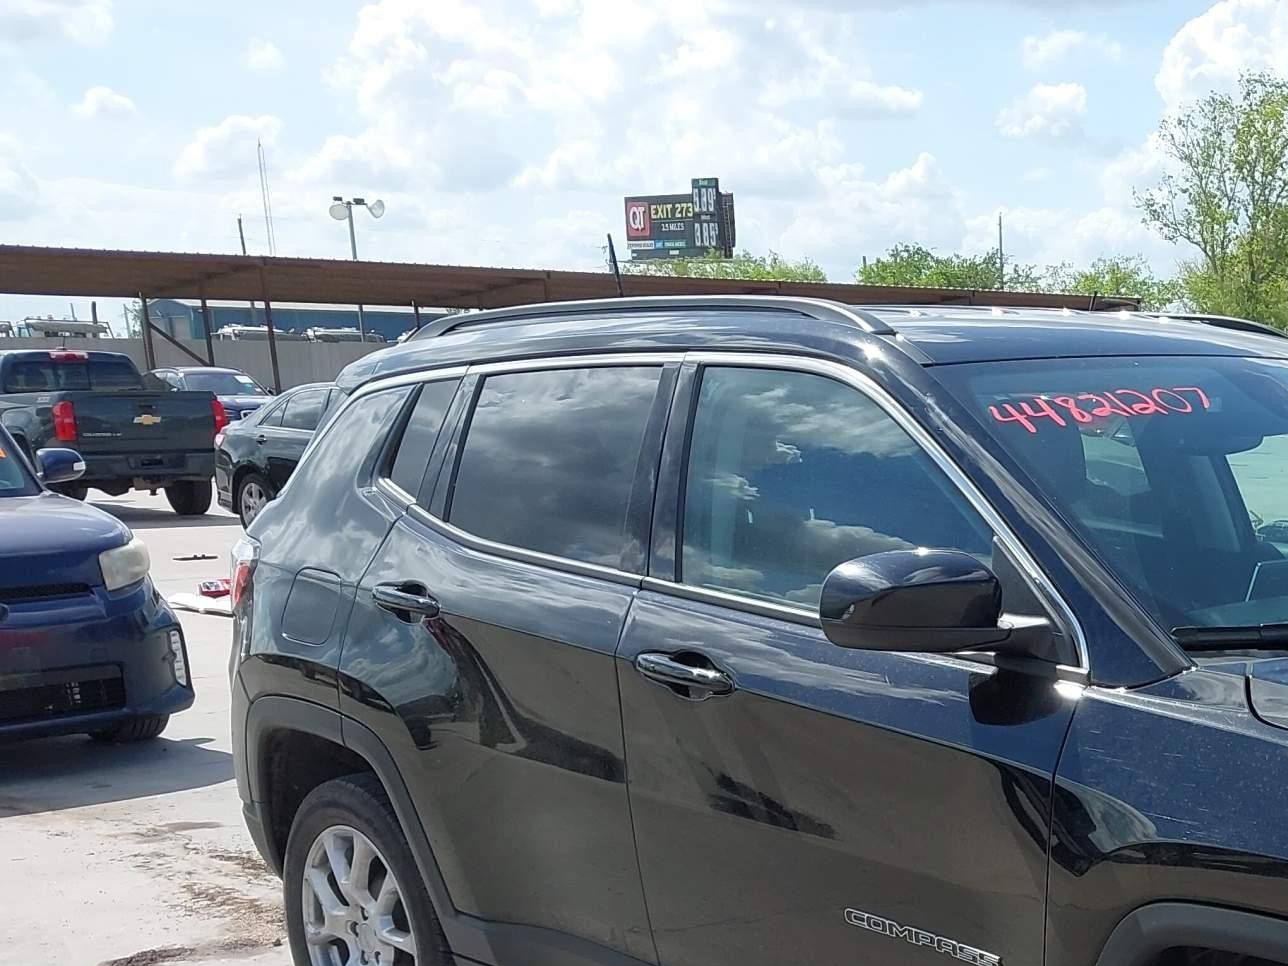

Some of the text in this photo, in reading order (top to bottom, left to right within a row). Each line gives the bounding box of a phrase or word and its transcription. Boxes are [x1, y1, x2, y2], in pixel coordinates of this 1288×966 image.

[629, 206, 645, 231] QT
[651, 202, 694, 219] EXIT 273
[988, 387, 1211, 433] 44821207
